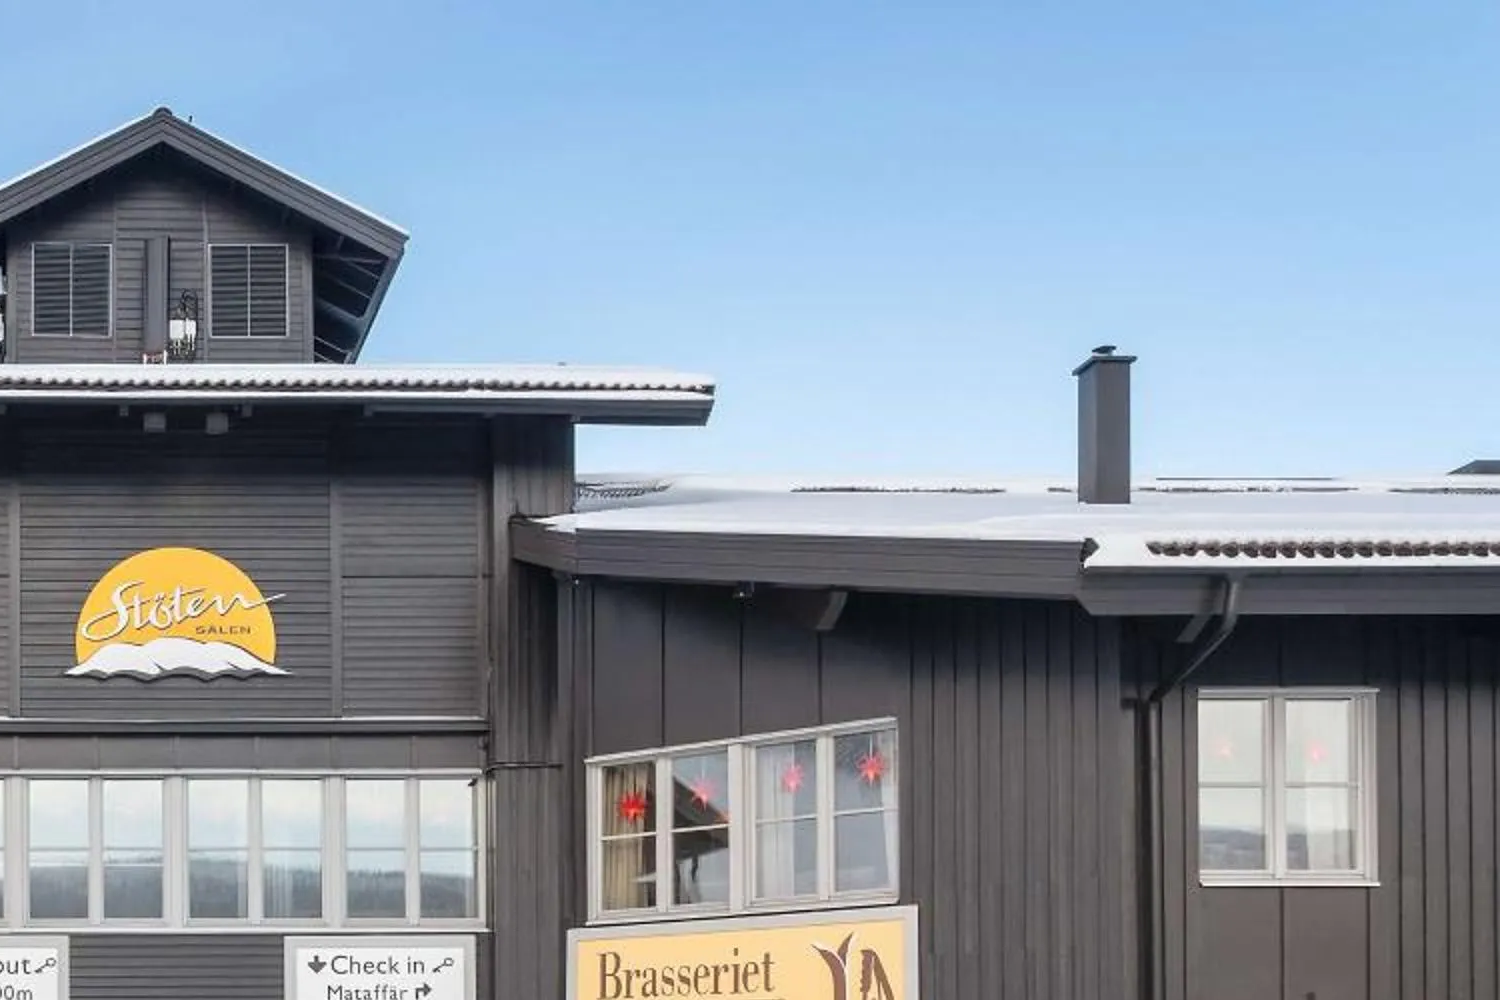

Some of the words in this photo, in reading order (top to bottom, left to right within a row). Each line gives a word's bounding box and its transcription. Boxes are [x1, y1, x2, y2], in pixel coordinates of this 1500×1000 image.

[81, 578, 287, 642] Stöten
[330, 955, 400, 975] Check
[407, 957, 425, 974] in
[596, 947, 776, 1000] Brasseriet
